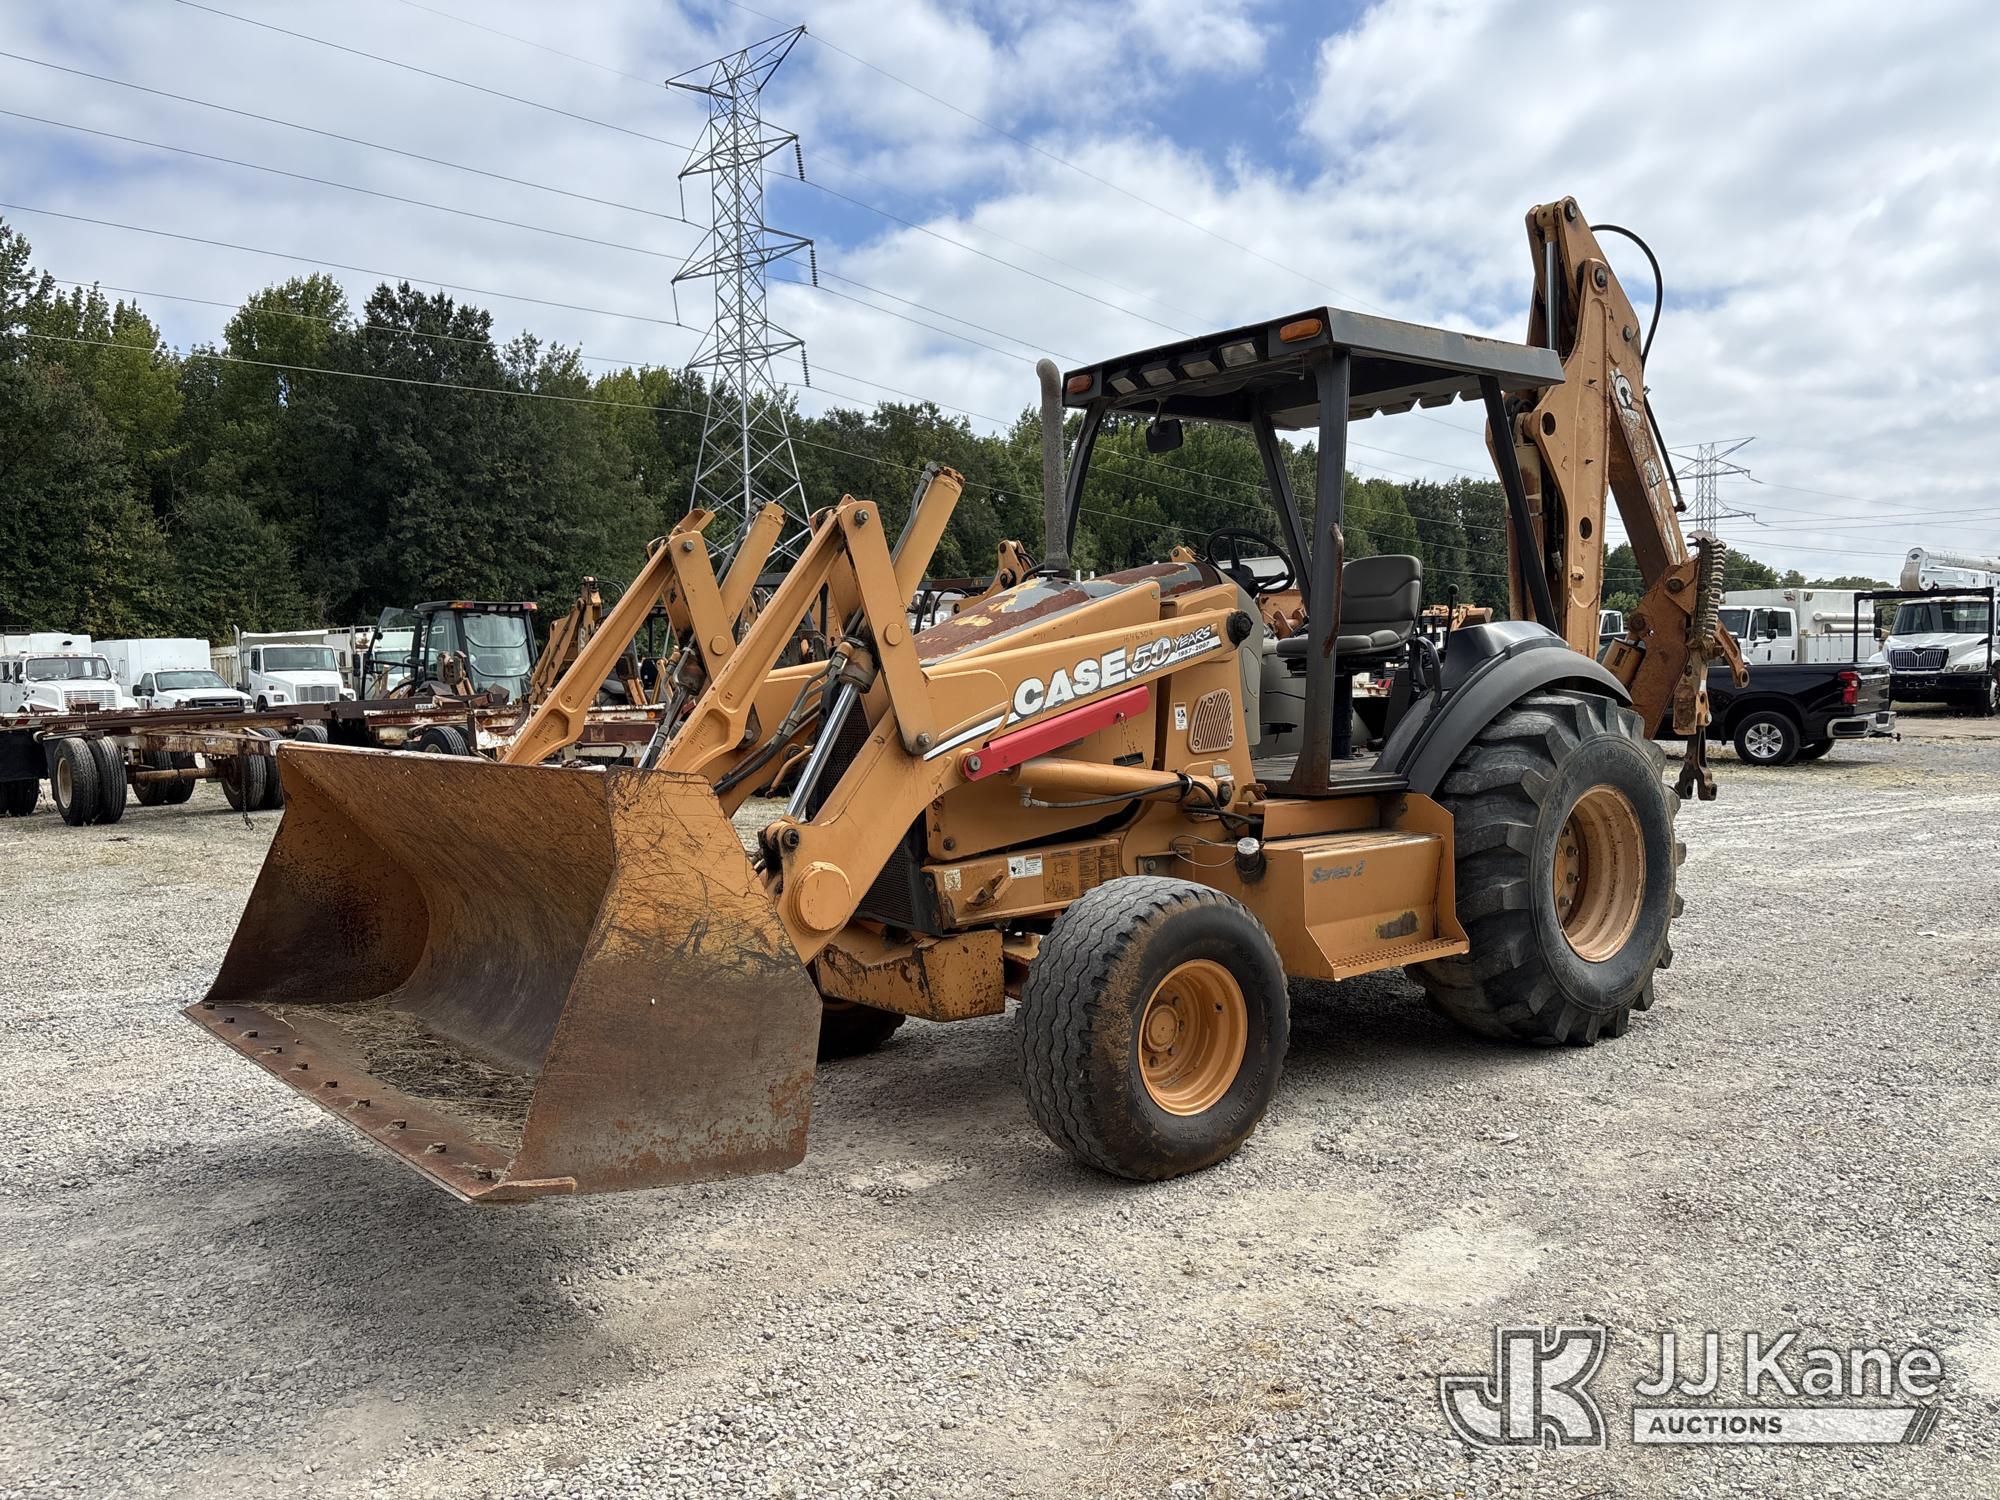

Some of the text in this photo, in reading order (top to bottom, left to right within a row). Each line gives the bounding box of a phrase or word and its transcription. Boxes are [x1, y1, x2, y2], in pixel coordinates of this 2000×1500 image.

[1177, 641, 1210, 658] 1957-2007
[1013, 624, 1211, 716] CASE 50 YEARS
[1310, 859, 1366, 884] Series 2
